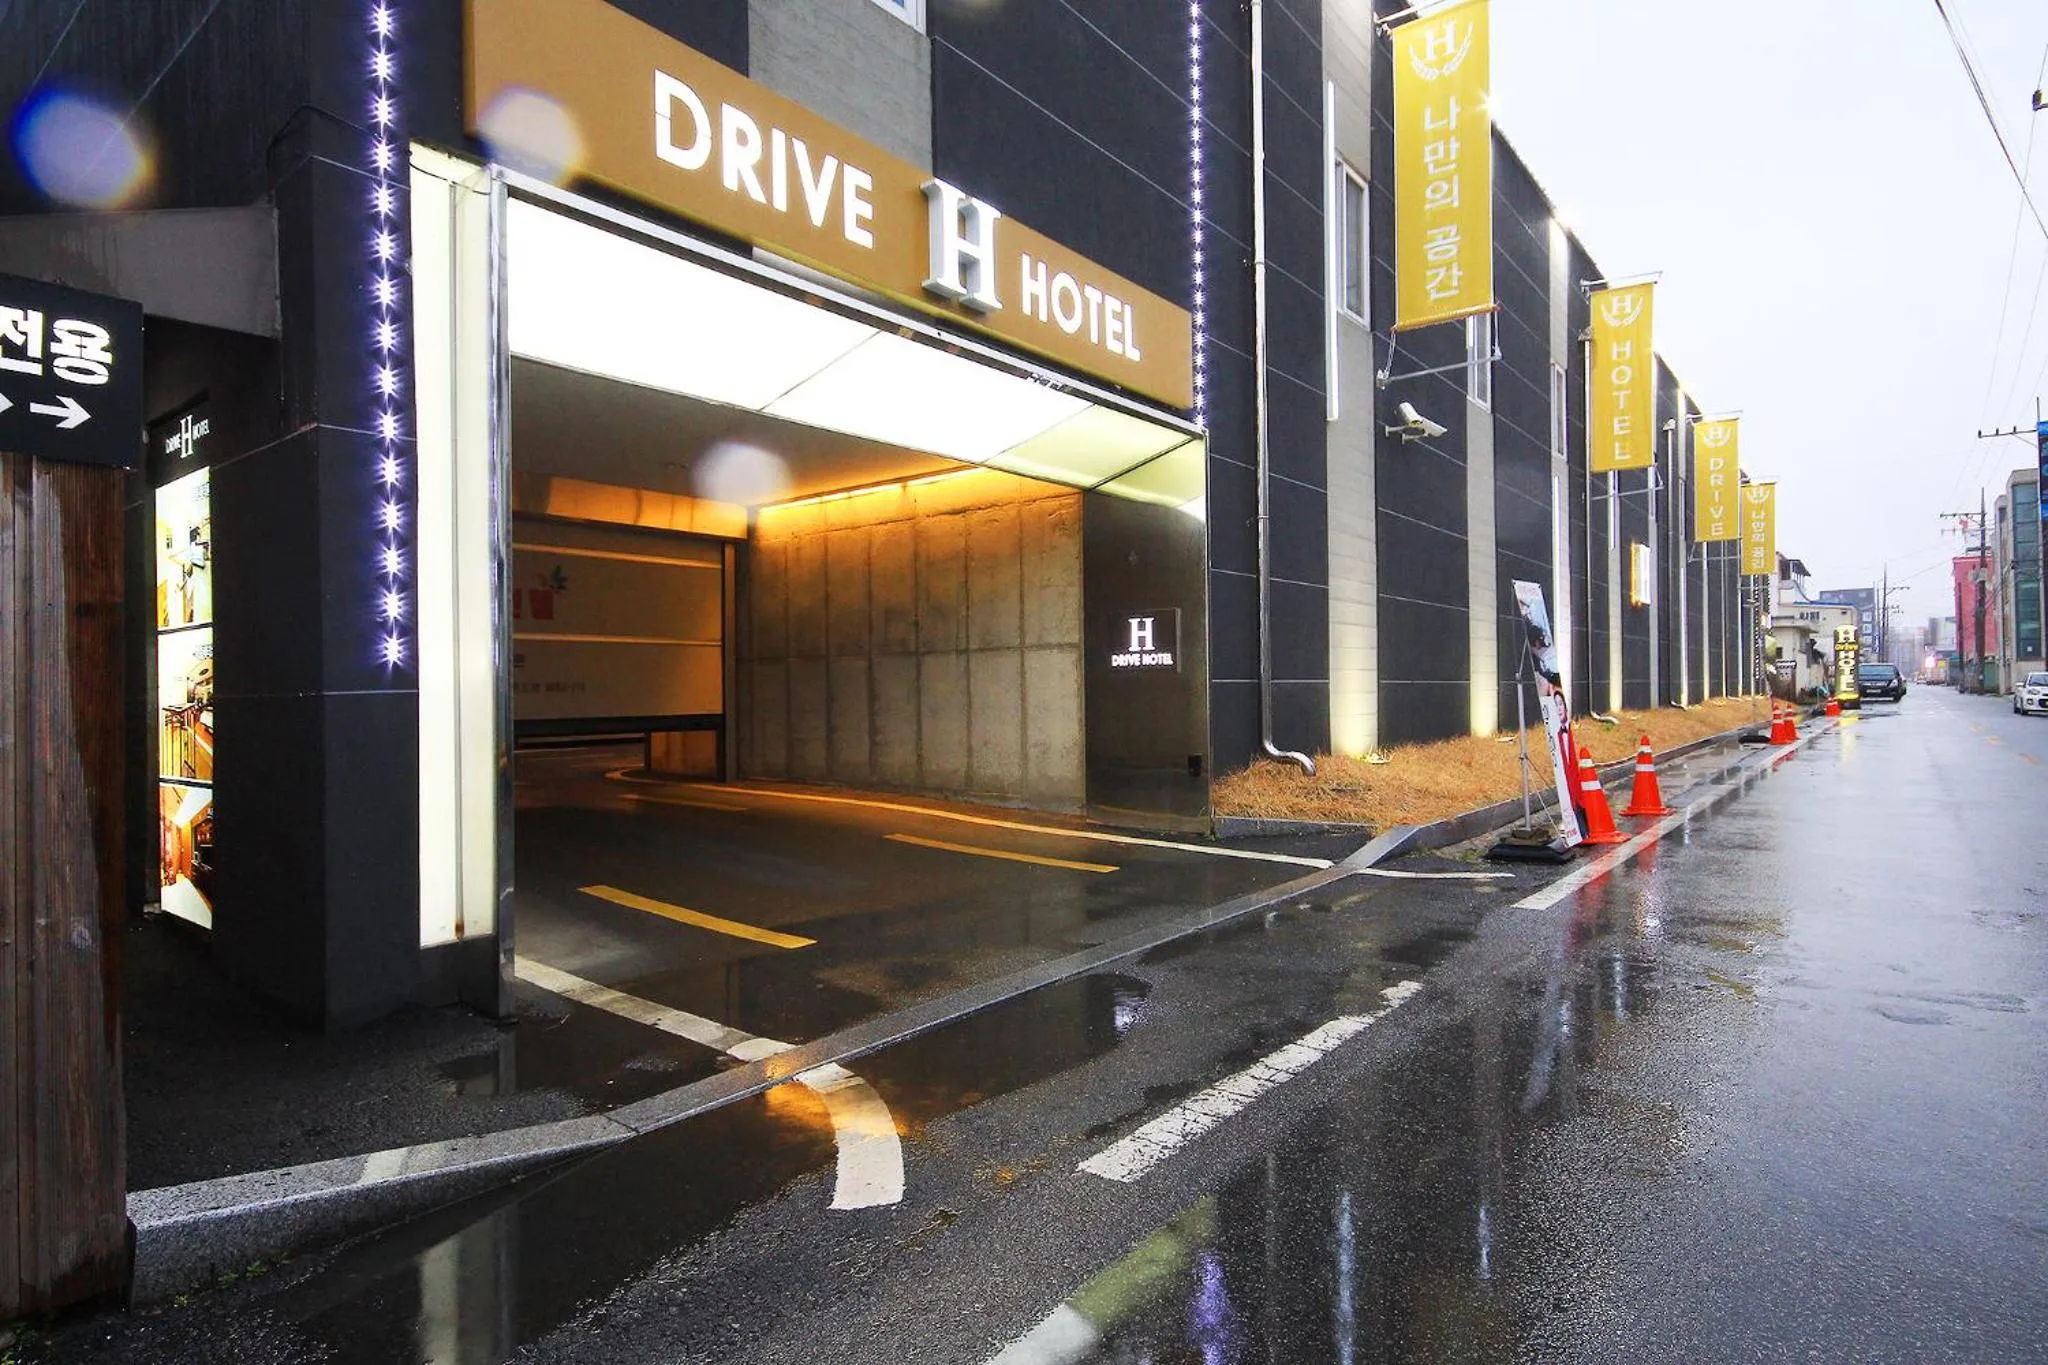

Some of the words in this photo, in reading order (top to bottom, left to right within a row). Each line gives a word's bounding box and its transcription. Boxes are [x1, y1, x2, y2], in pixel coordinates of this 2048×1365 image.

[1424, 20, 1457, 62] H
[1424, 95, 1461, 211] 나만의
[654, 68, 875, 249] DRIVE
[919, 177, 1002, 314] H
[1020, 251, 1141, 362] HOTEL
[1424, 223, 1463, 301] 공간
[1611, 293, 1632, 316] H
[1611, 339, 1633, 461] HOTEL
[180, 414, 194, 459] H
[1709, 457, 1725, 537] DRIVE
[1111, 653, 1140, 667] DRIVE
[1142, 653, 1174, 666] HOTEL
[1128, 617, 1156, 652] H
